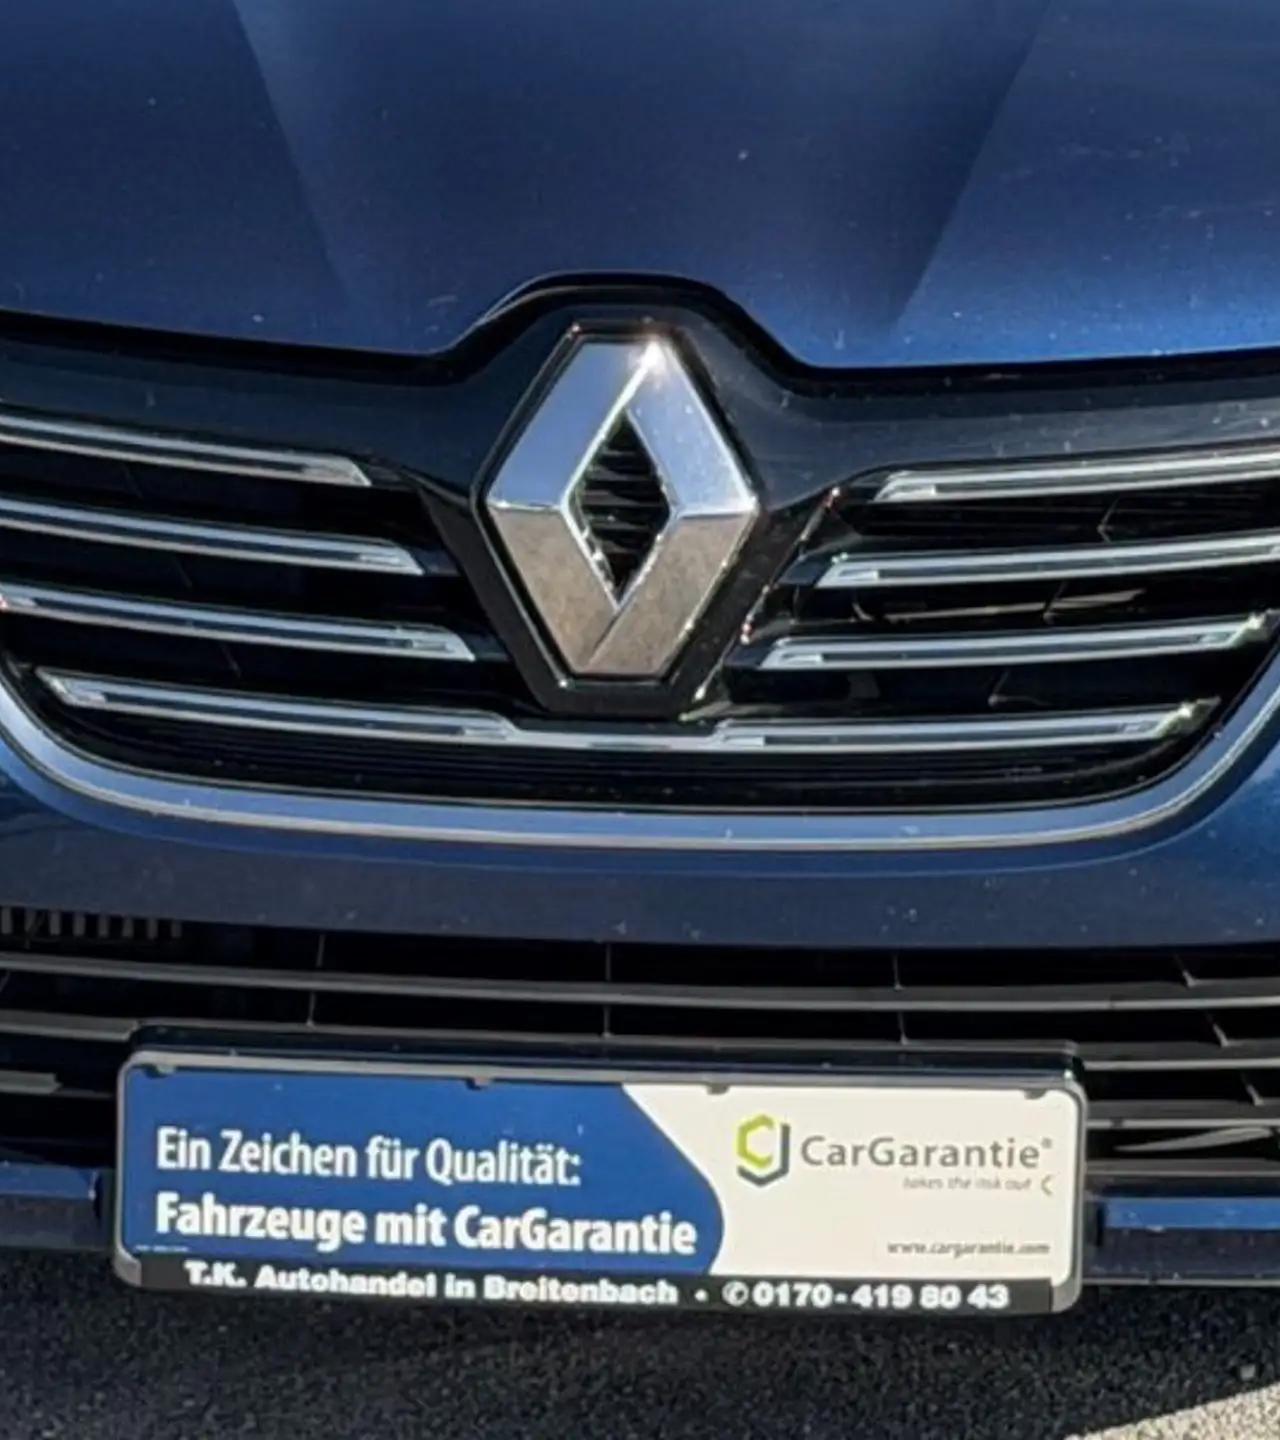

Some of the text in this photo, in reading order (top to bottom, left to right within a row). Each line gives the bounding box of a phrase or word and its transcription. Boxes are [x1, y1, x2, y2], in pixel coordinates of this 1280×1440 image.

[157, 1125, 582, 1186] Ein Zeichen für Qualität:
[800, 1134, 1041, 1169] CarGarantie
[156, 1190, 699, 1255] Fahrzeuge mit CarGarantie
[183, 1259, 248, 1288] T.K.
[254, 1264, 437, 1298] Autohandel
[444, 1272, 476, 1299] in
[483, 1274, 679, 1305] Breitenbach
[967, 1284, 1011, 1310] 43
